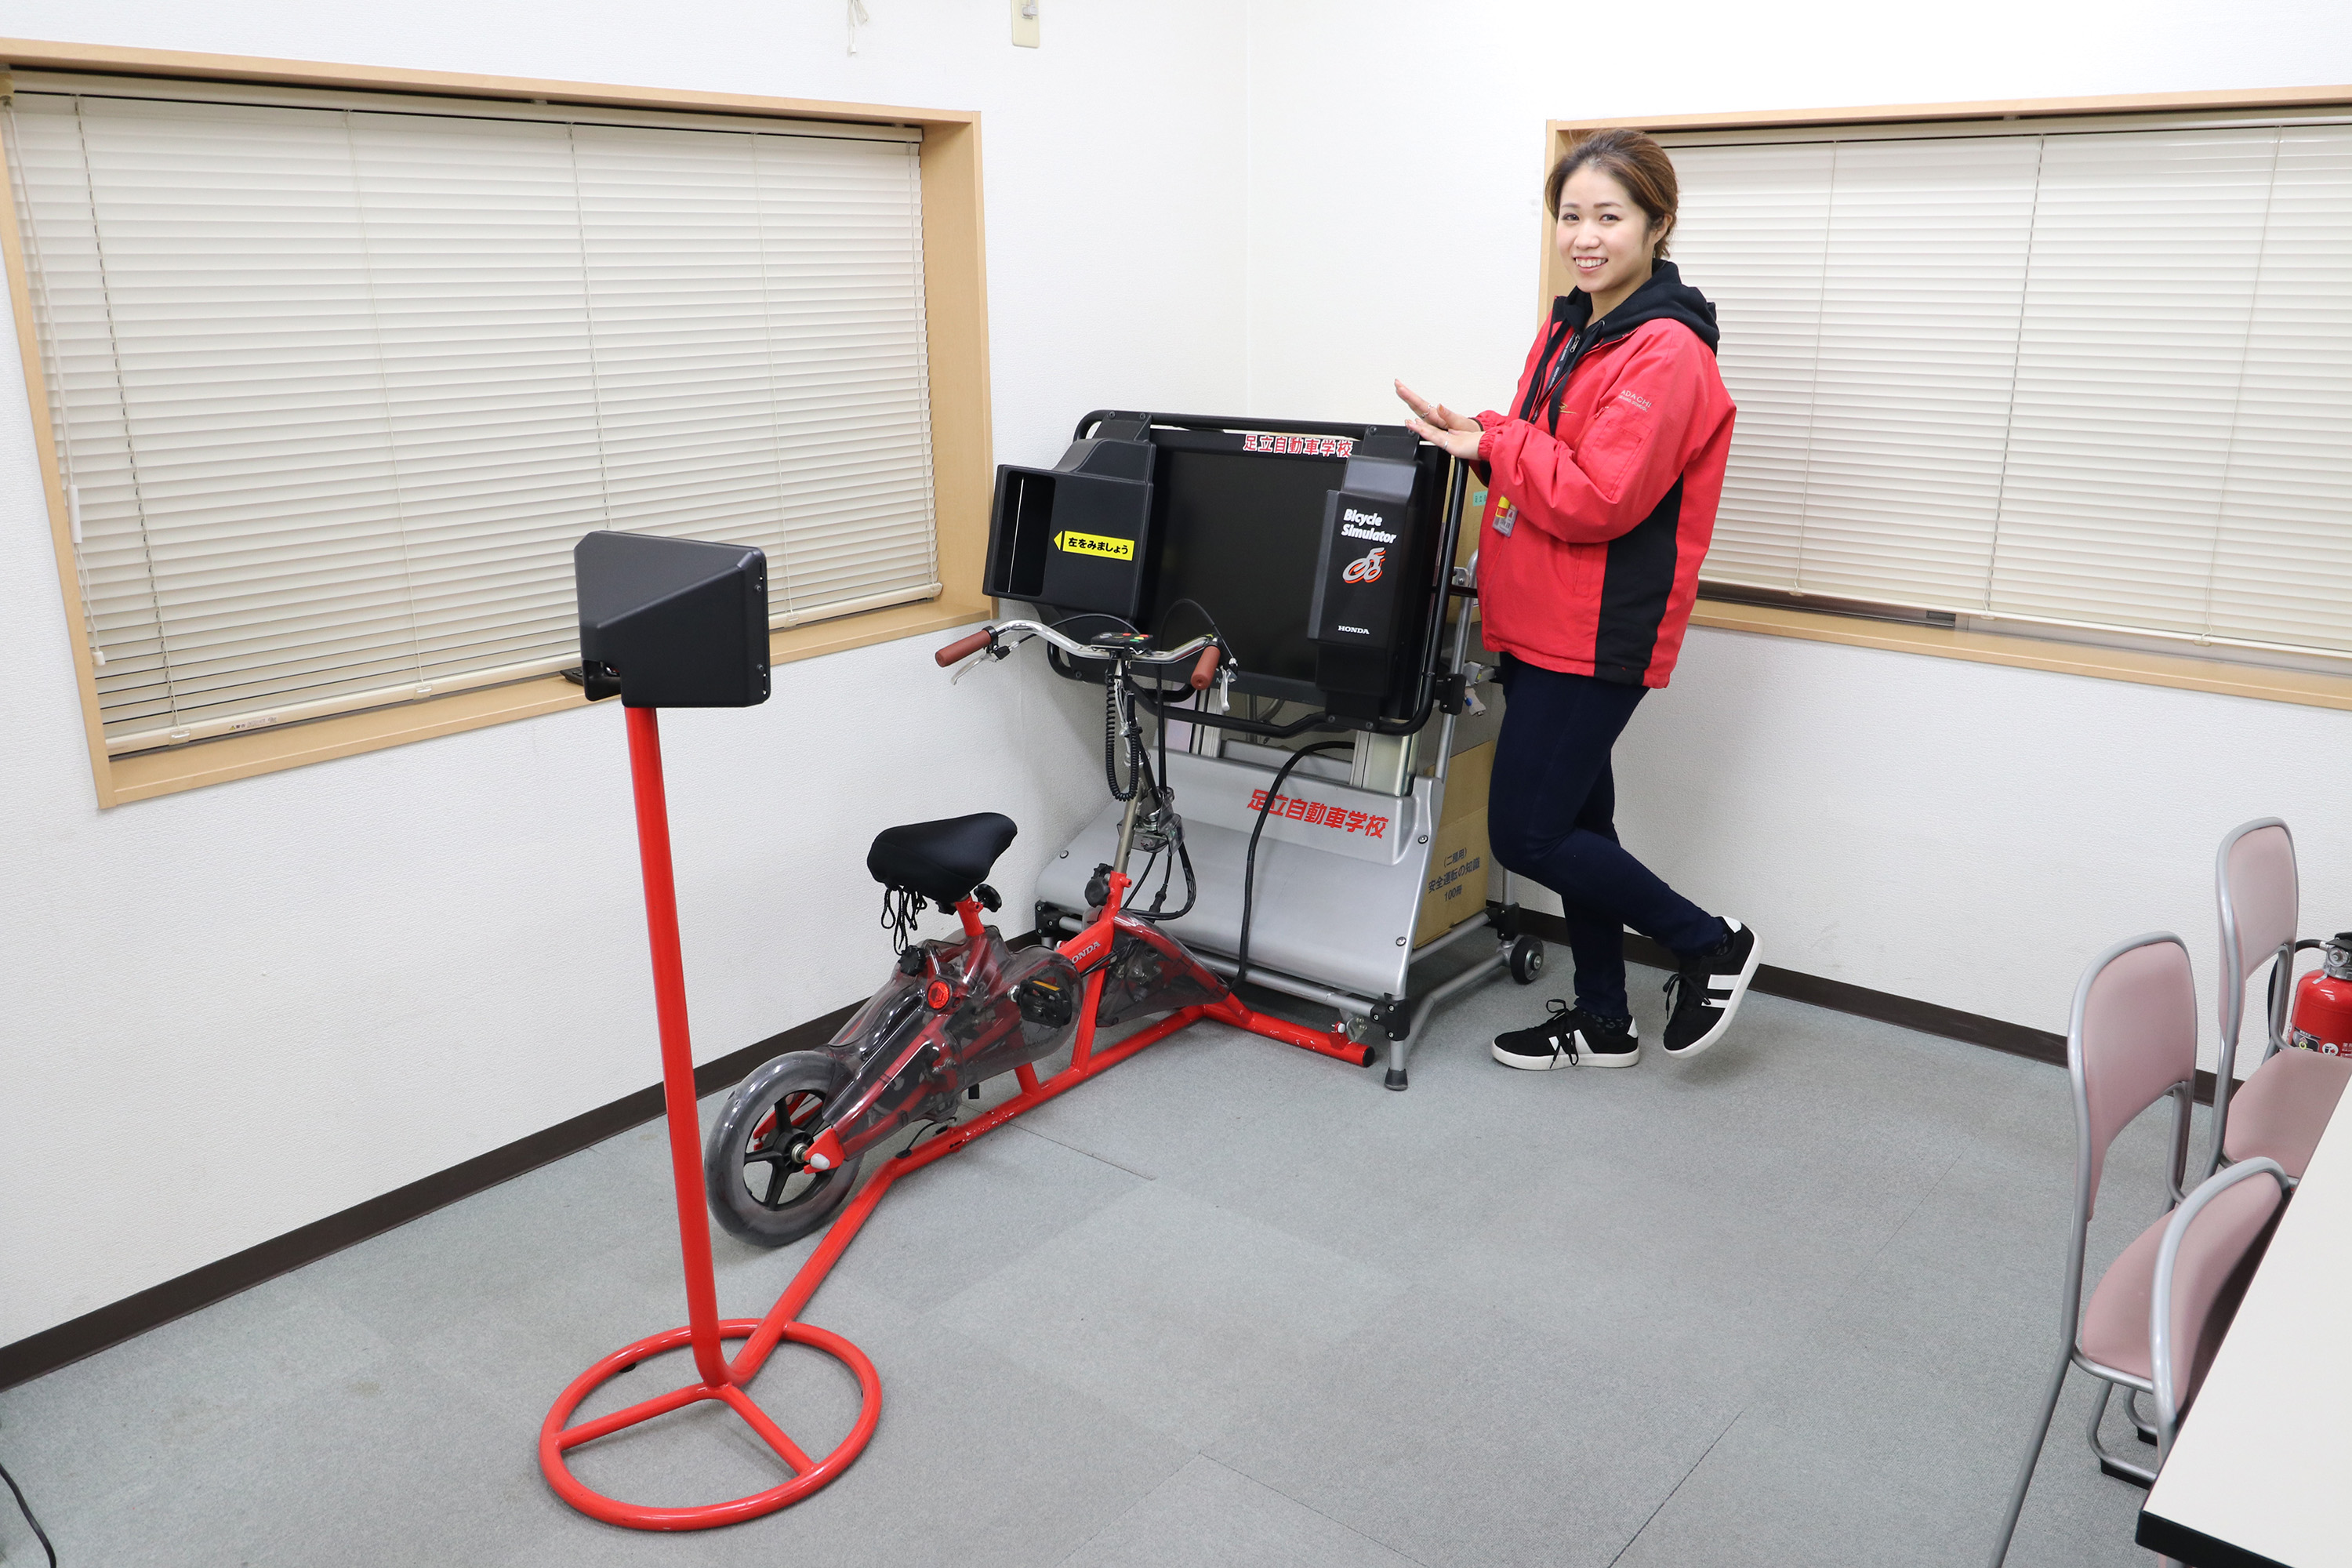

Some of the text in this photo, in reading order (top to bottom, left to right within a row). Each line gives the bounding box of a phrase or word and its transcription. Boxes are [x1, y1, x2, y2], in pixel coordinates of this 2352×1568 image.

[1621, 390, 1652, 408] ADACHI
[1243, 434, 1353, 458] 足立自動車学校
[1343, 509, 1383, 526] Bicycle
[1341, 524, 1397, 543] Simulator
[1068, 537, 1128, 554] 左をみましょう
[1338, 626, 1370, 634] HONDA
[1247, 789, 1389, 839] 足立自動車学校
[1071, 941, 1101, 964] ONDA
